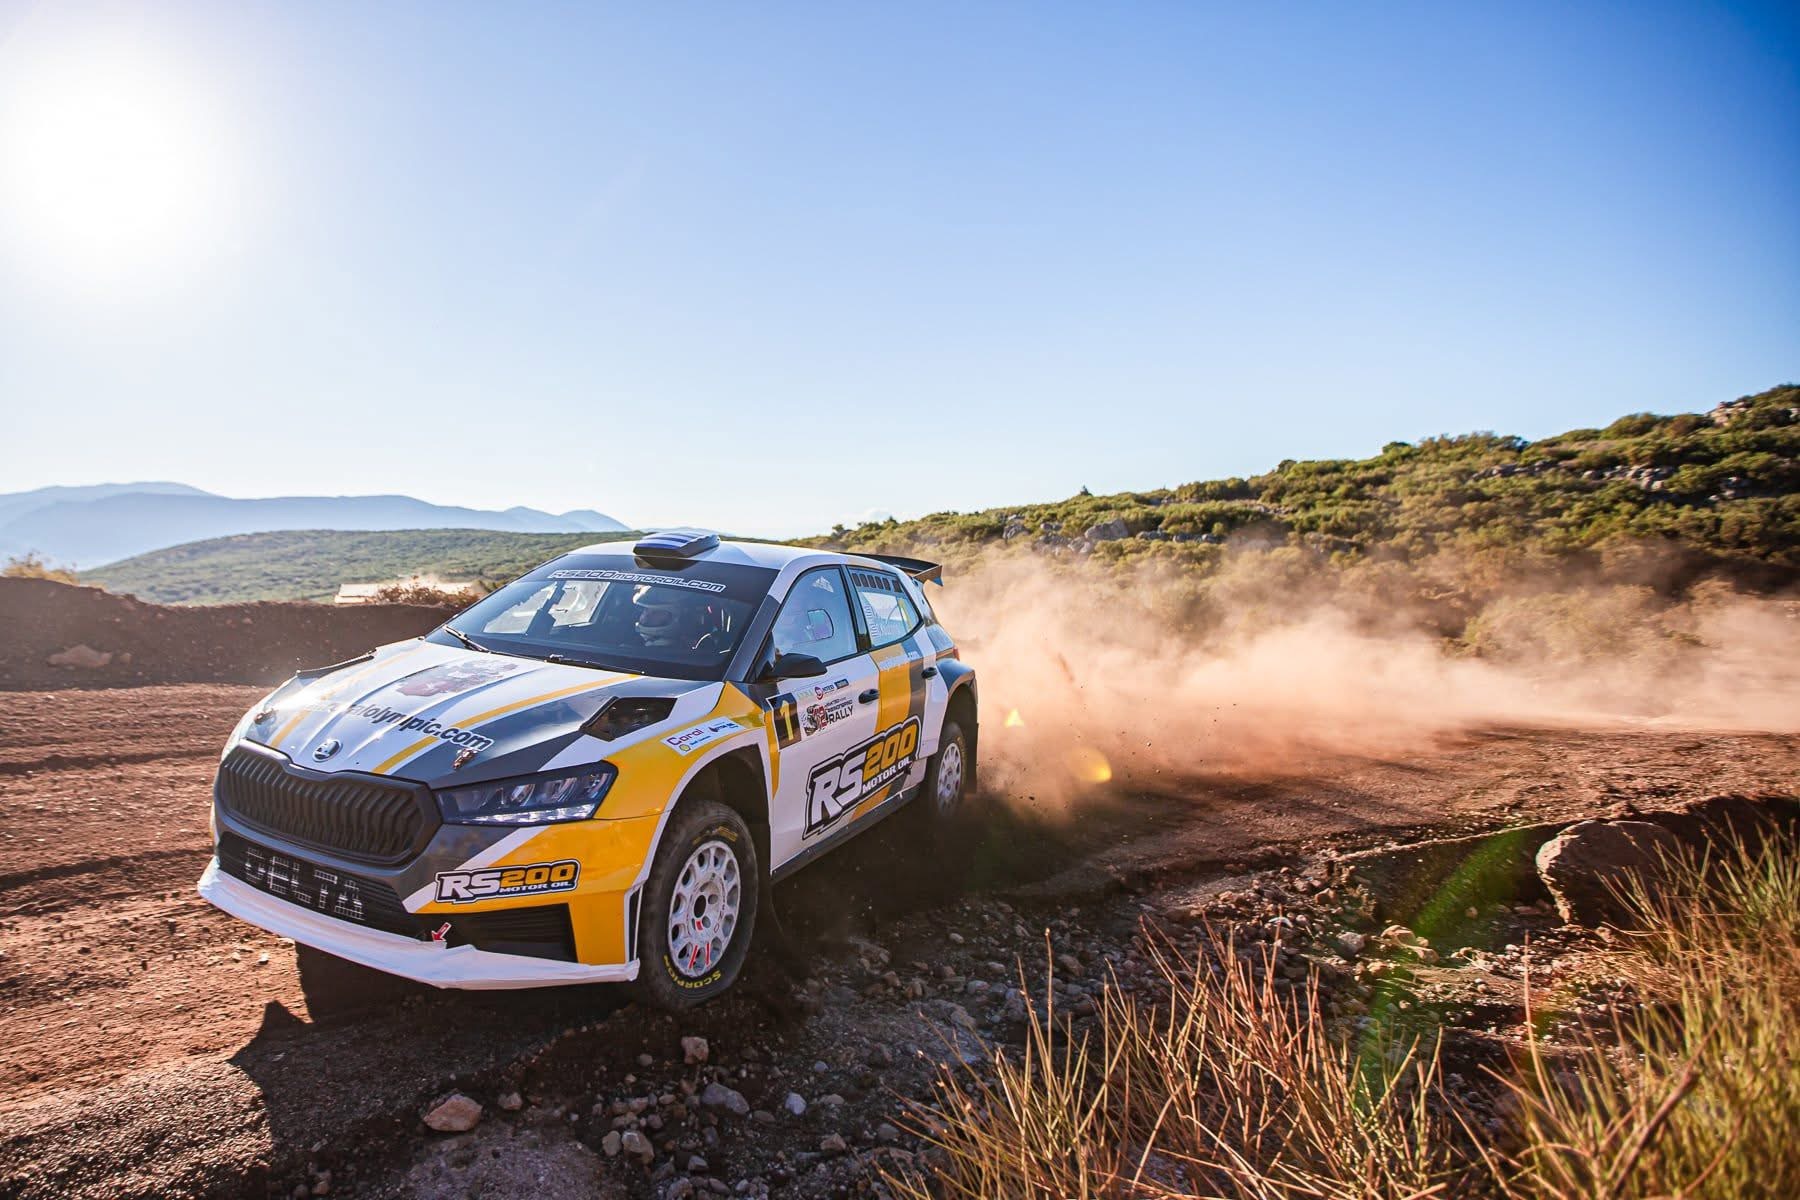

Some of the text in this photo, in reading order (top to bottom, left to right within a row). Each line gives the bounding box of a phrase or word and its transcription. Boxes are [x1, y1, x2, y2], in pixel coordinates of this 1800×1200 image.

[780, 700, 794, 740] 1
[828, 705, 854, 724] RALLY
[667, 728, 704, 746] Coral
[811, 724, 917, 825] RS200
[862, 757, 911, 794] MOTOR OIL
[243, 847, 366, 921] DELTA
[440, 863, 576, 898] RS200
[499, 883, 548, 893] MOTOR
